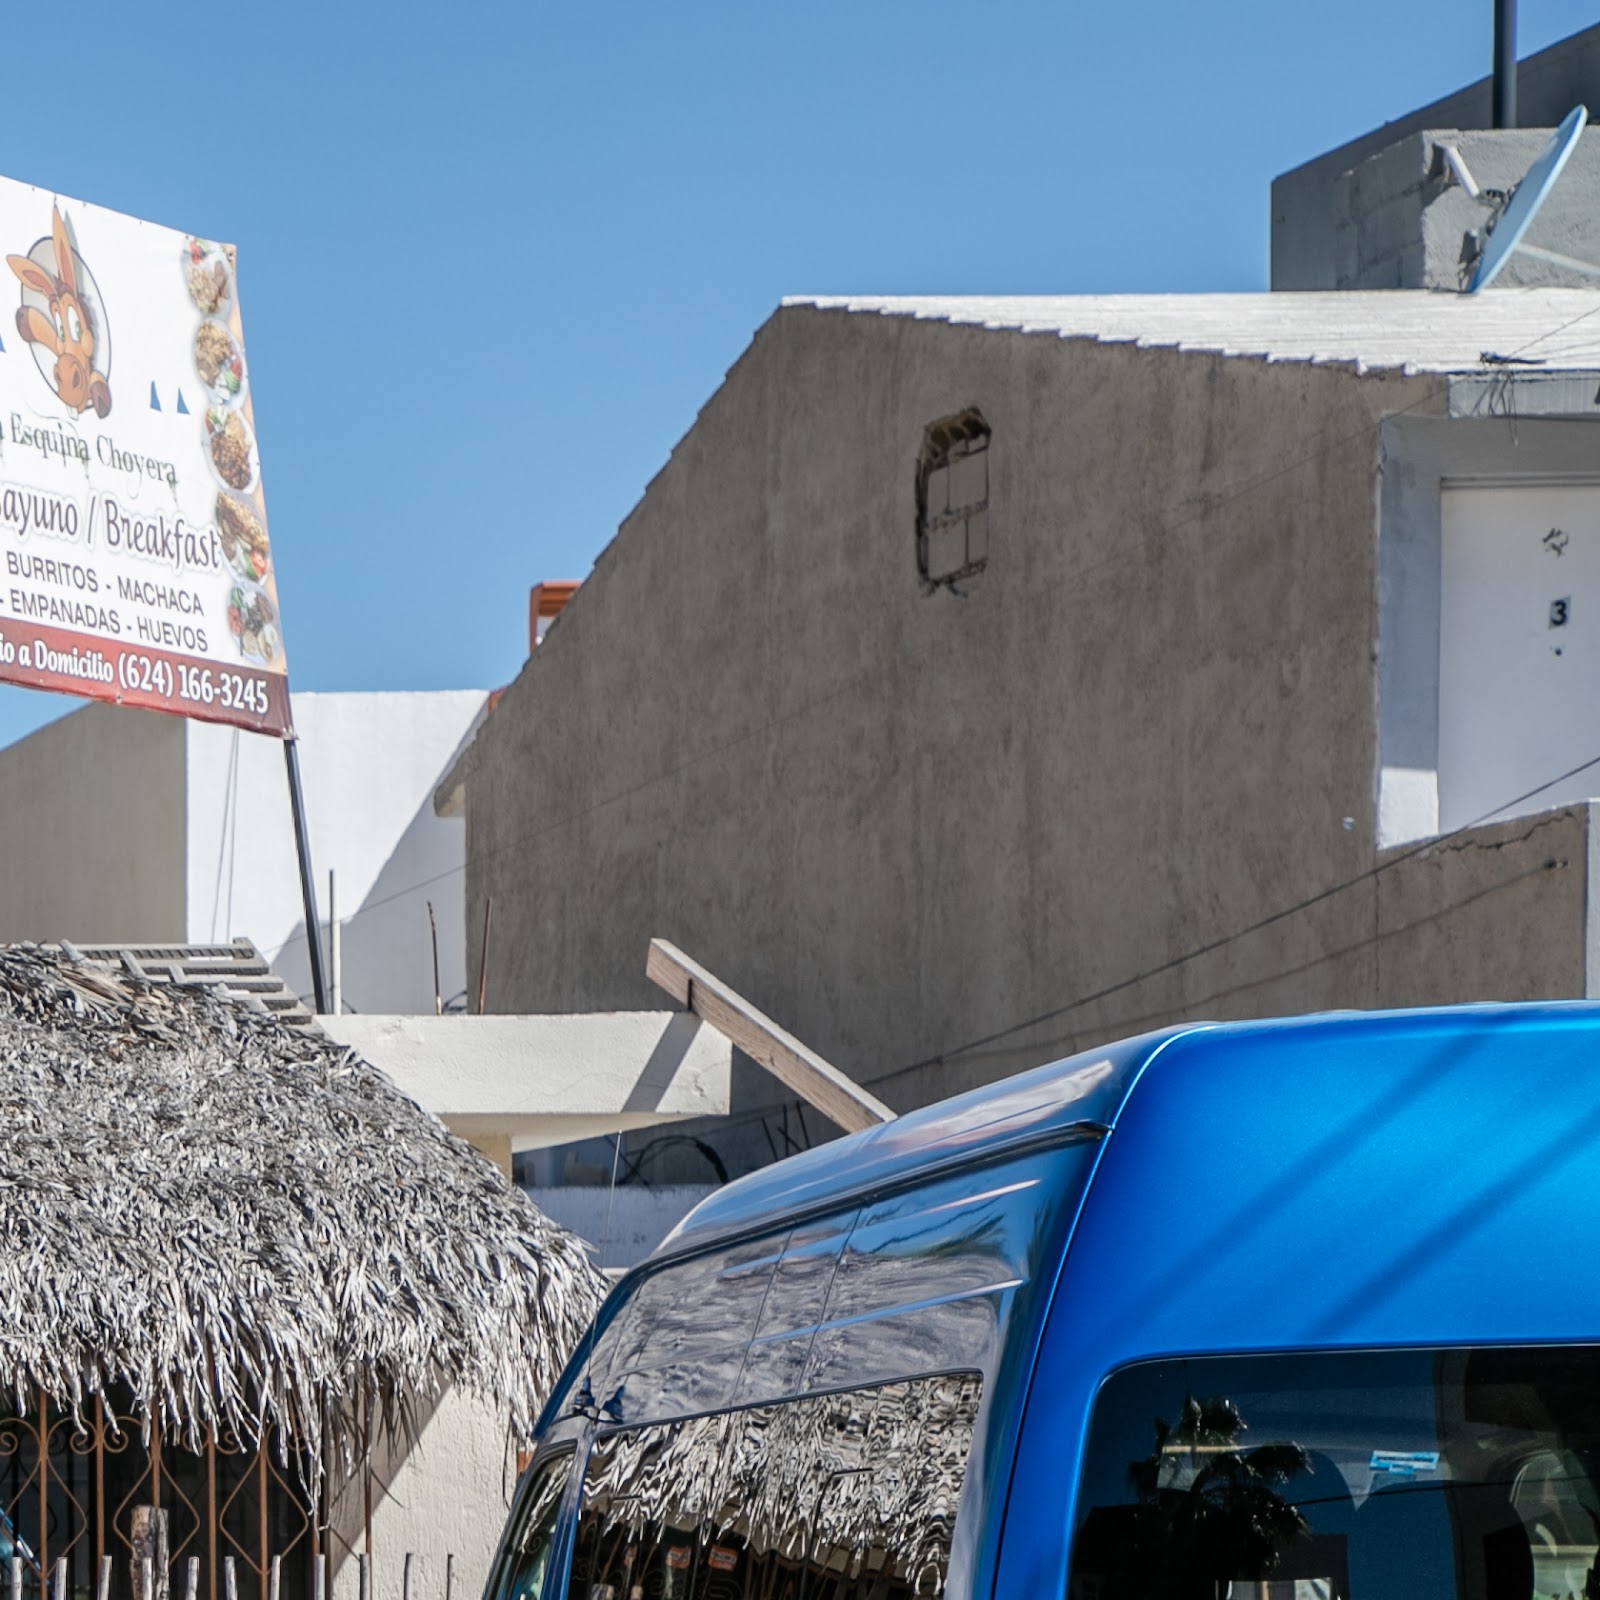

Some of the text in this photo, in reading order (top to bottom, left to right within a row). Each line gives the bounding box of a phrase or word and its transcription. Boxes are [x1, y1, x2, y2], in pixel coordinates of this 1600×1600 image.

[10, 412, 91, 463] Esquina
[96, 434, 178, 490] Choyera
[105, 498, 221, 569] Breakfast
[7, 550, 99, 593] BURRITOS
[117, 576, 205, 617] MACHACA
[1551, 600, 1568, 626] 3
[10, 588, 121, 635] EMPANADAS
[137, 616, 208, 652] HUEVOS
[18, 644, 31, 666] a
[34, 640, 114, 683] Domicilio
[118, 652, 173, 697] (624)
[177, 664, 269, 714] 166-3245
